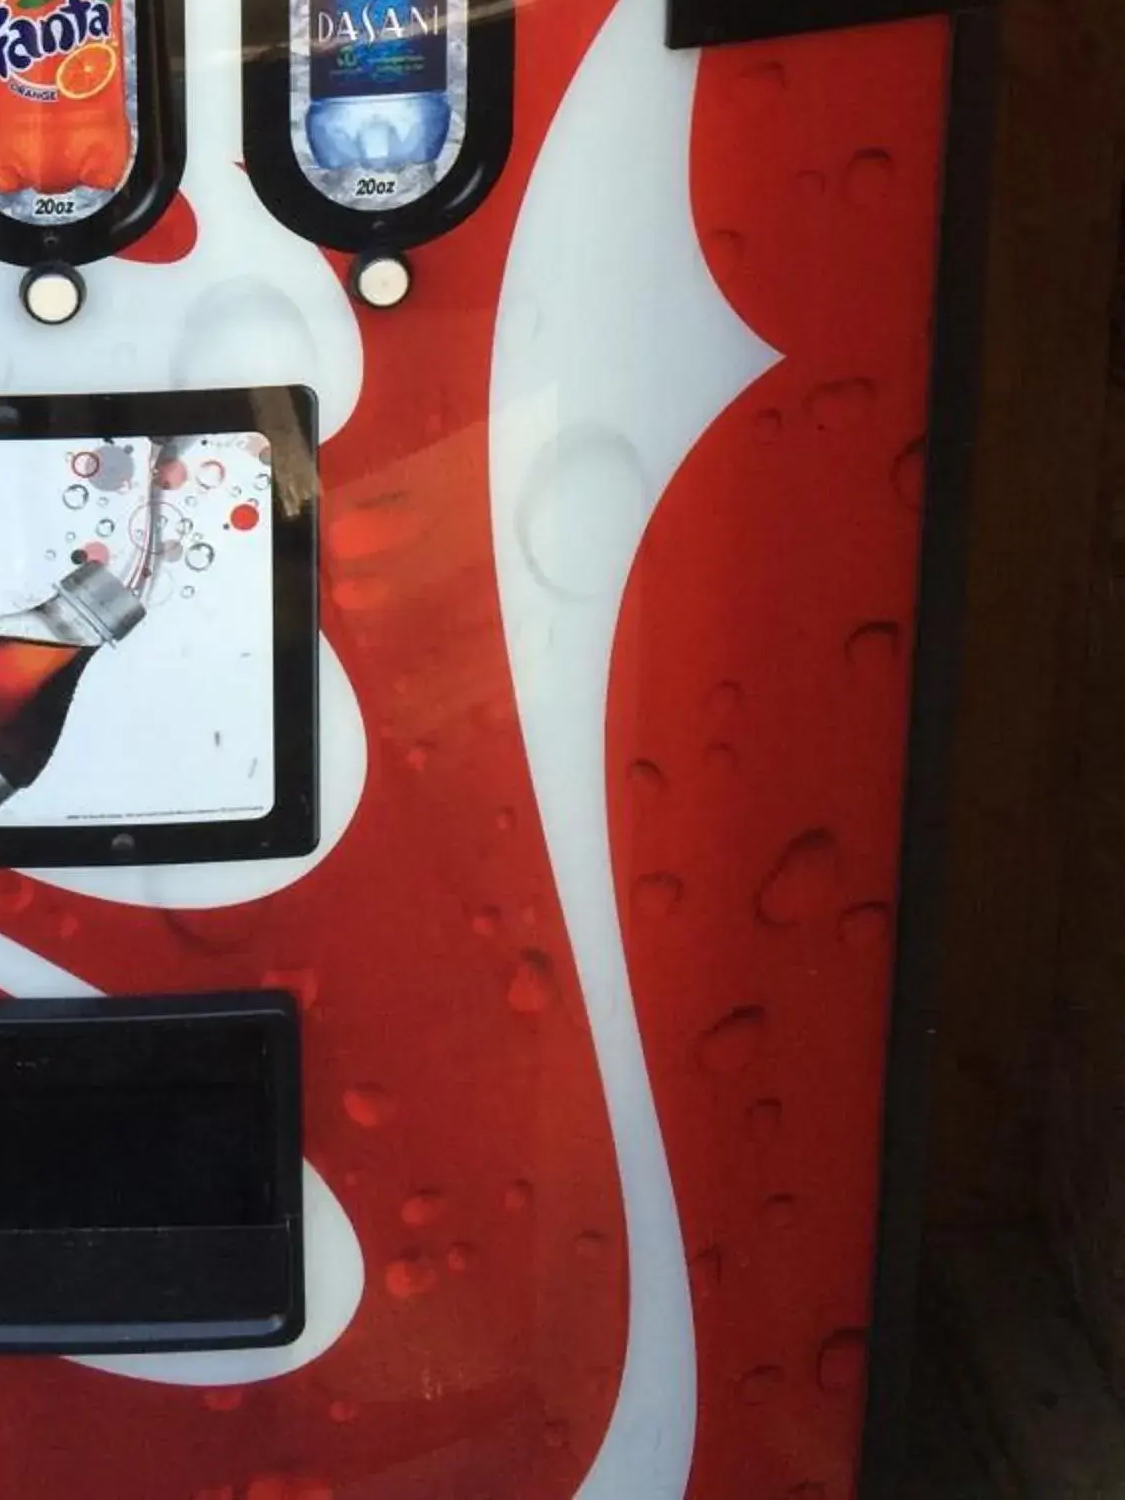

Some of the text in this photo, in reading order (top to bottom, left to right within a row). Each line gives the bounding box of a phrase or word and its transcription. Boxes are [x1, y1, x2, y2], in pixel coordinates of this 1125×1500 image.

[318, 3, 439, 44] DASANI
[9, 82, 58, 101] ORANGE
[356, 179, 395, 197] 20oz
[34, 198, 75, 216] 20oz
